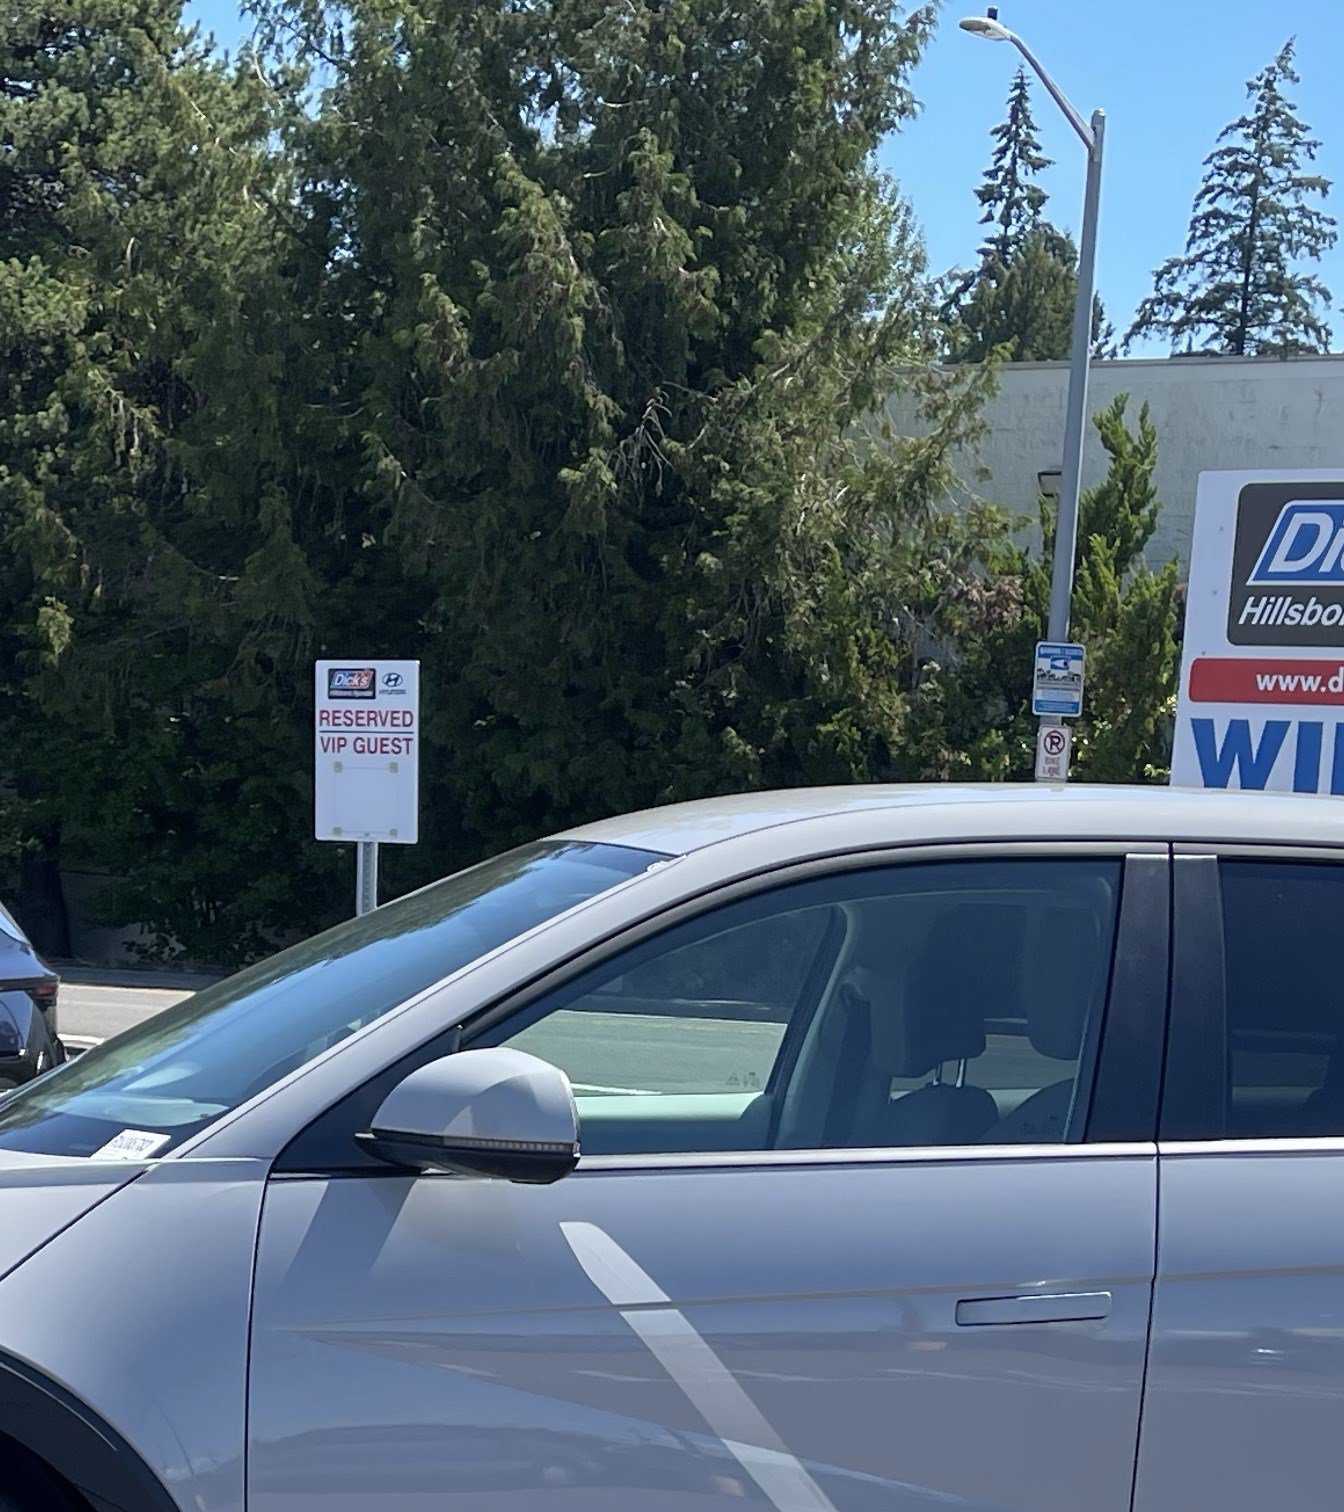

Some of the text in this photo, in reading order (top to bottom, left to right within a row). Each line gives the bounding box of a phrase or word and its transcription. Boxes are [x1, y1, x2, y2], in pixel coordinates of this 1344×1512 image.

[319, 709, 414, 728] RESERVED
[320, 736, 413, 755] VIP GUEST
